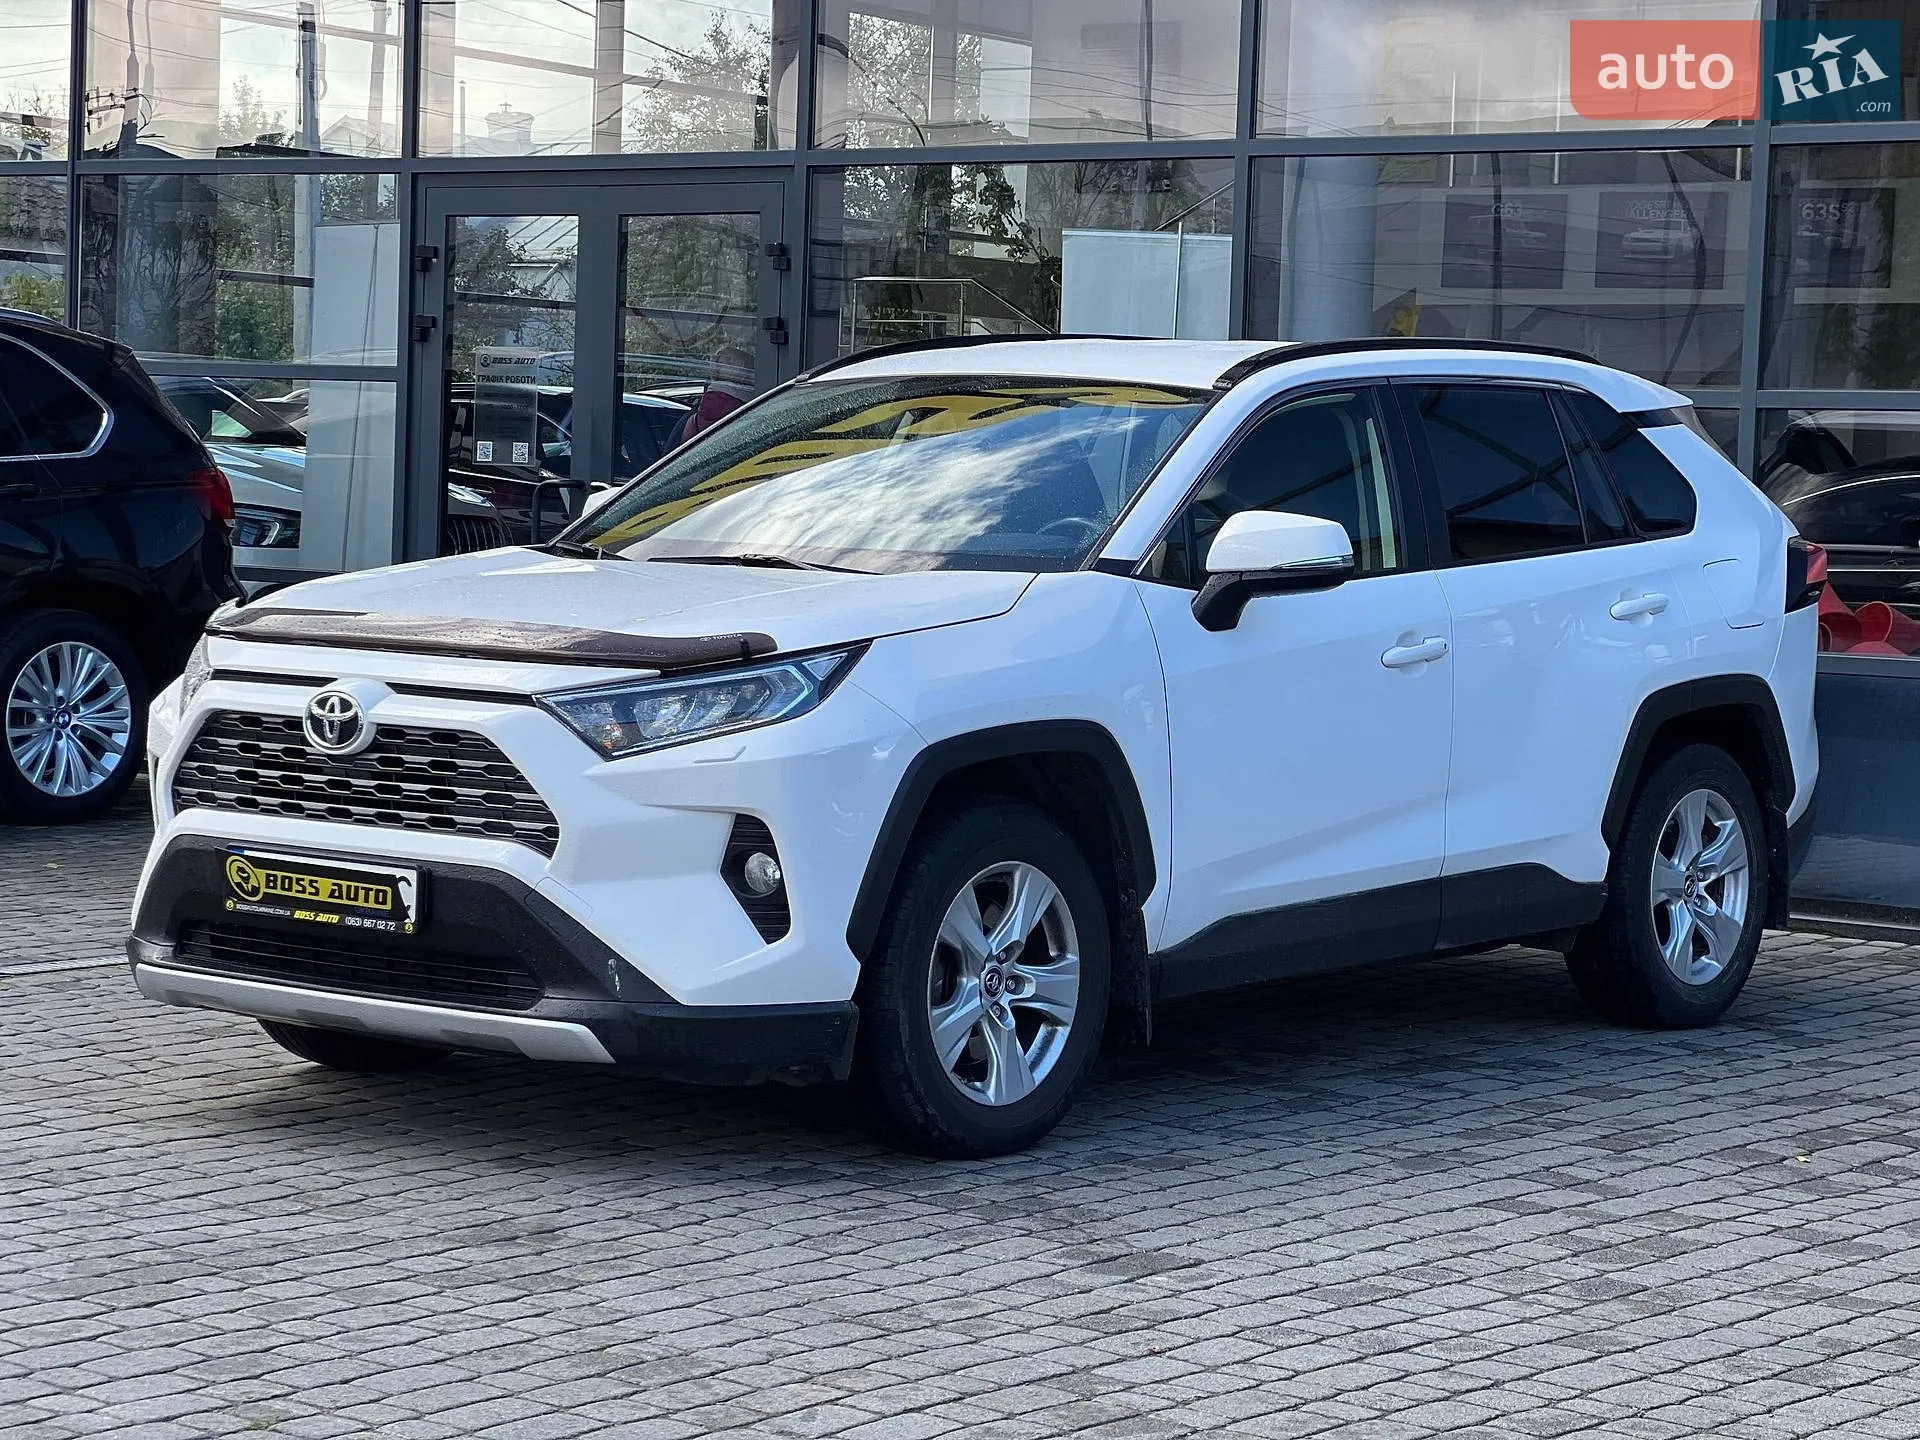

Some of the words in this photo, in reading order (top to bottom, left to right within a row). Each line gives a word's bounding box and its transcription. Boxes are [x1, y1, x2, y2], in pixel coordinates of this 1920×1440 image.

[491, 357, 513, 365] BOSS
[513, 357, 536, 365] AUTO
[477, 375, 504, 384] ГРАФІК
[505, 375, 536, 384] РОБОТИ
[265, 872, 320, 897] BOSS
[327, 882, 389, 906] AUTO
[293, 910, 316, 921] BOSS
[315, 913, 340, 924] AUTO
[345, 916, 362, 927] (063)
[362, 919, 376, 928] 667
[376, 921, 386, 930] 02
[386, 921, 396, 931] 72
